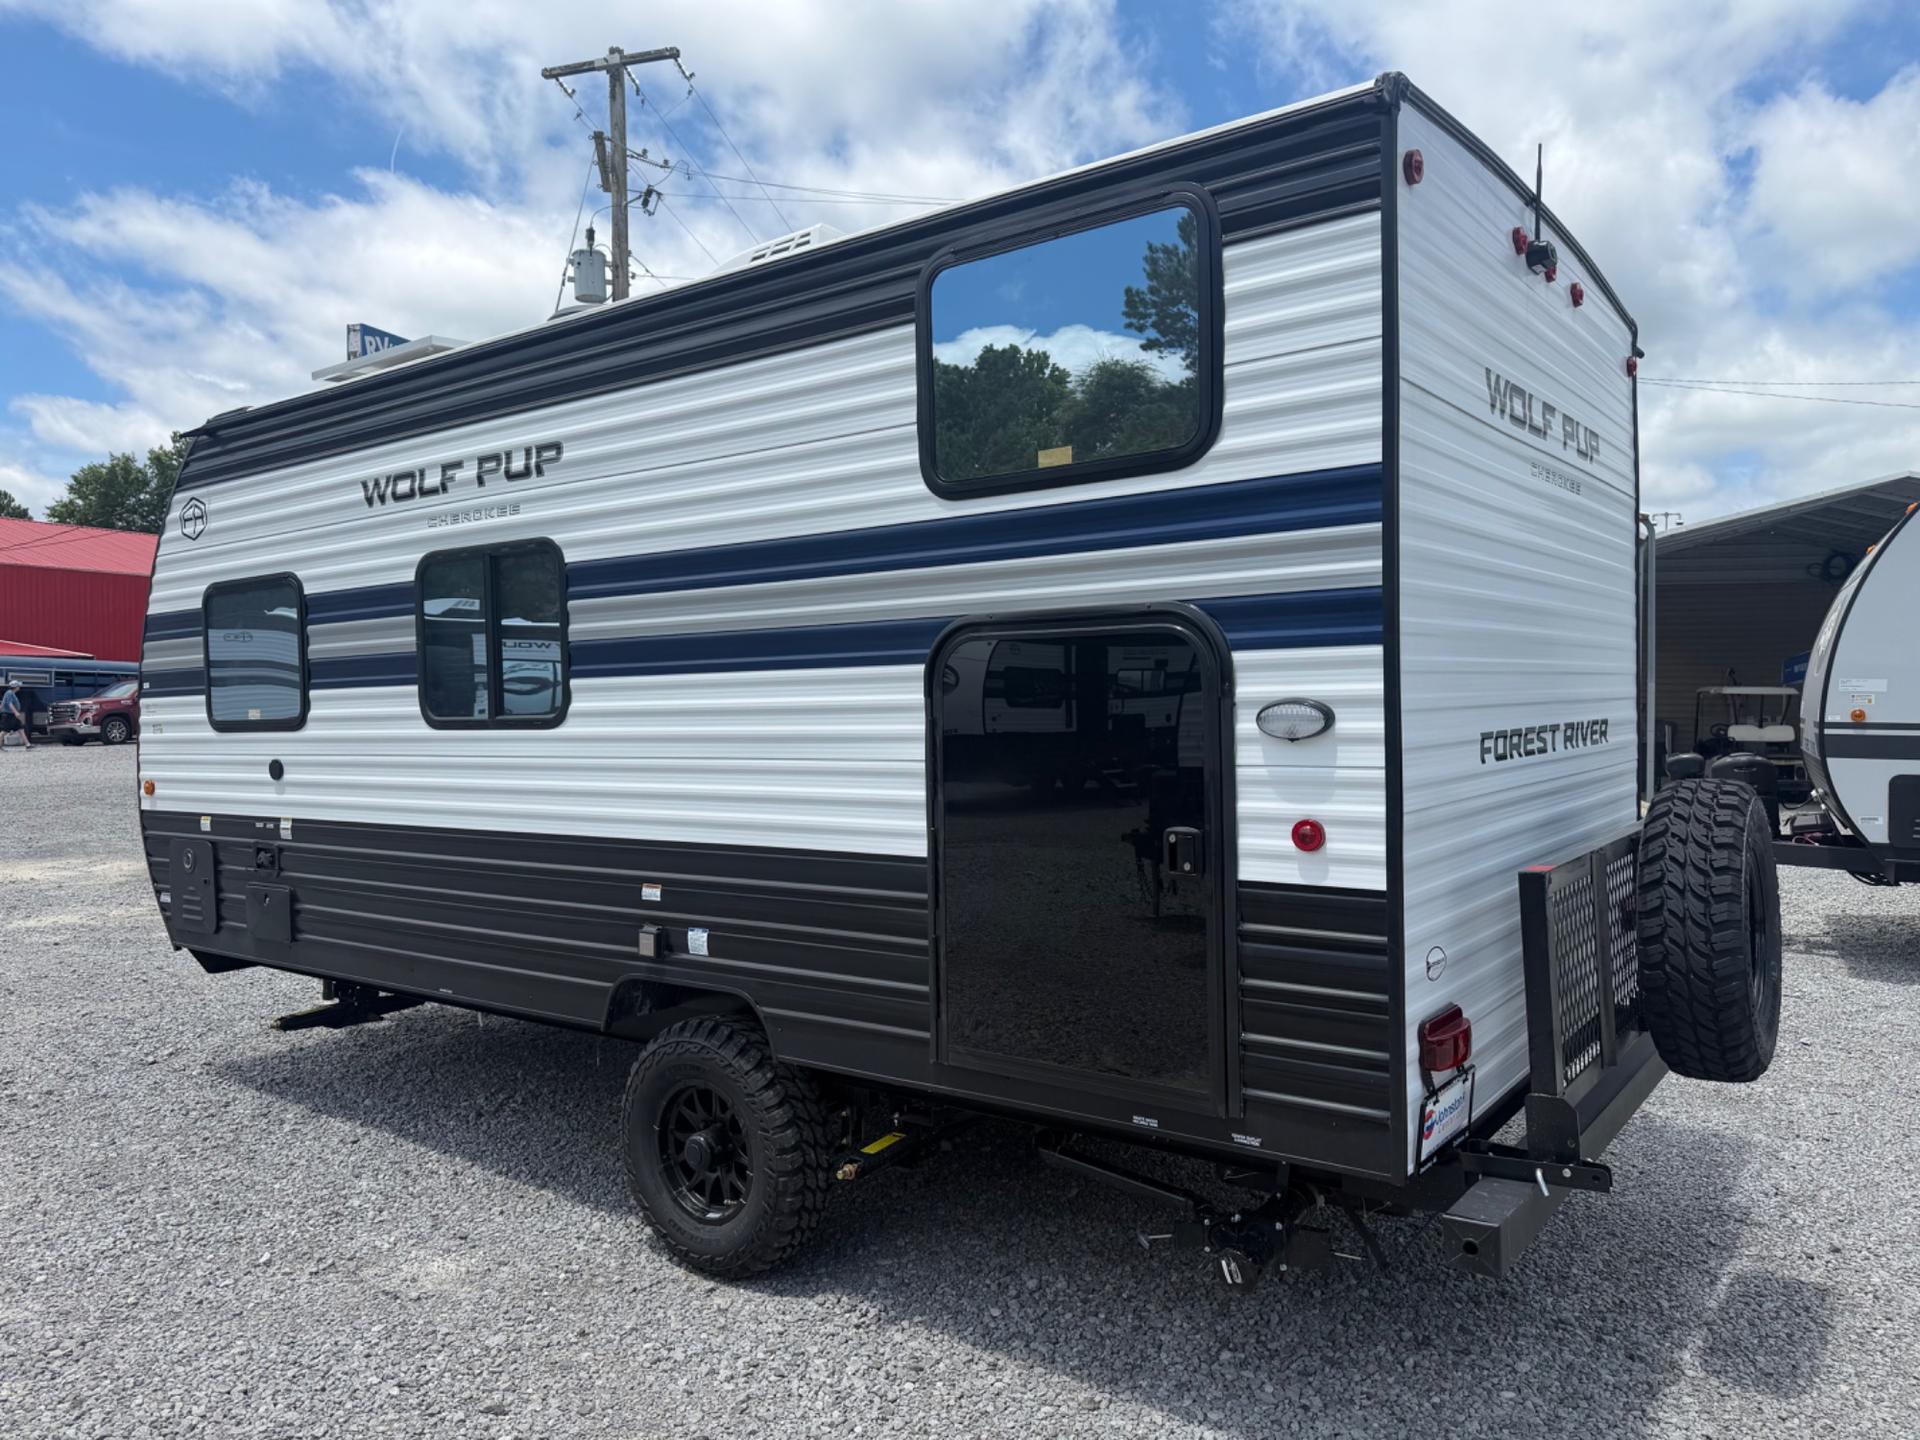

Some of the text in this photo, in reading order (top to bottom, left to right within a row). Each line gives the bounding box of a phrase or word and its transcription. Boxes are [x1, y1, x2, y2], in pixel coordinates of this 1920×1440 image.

[1485, 367, 1600, 464] WOLF PUP
[361, 441, 564, 508] WOLF PUP
[1530, 462, 1582, 495] CHEROKEE
[428, 503, 521, 528] CHEROKEE
[1480, 718, 1609, 764] FOREST RIVER
